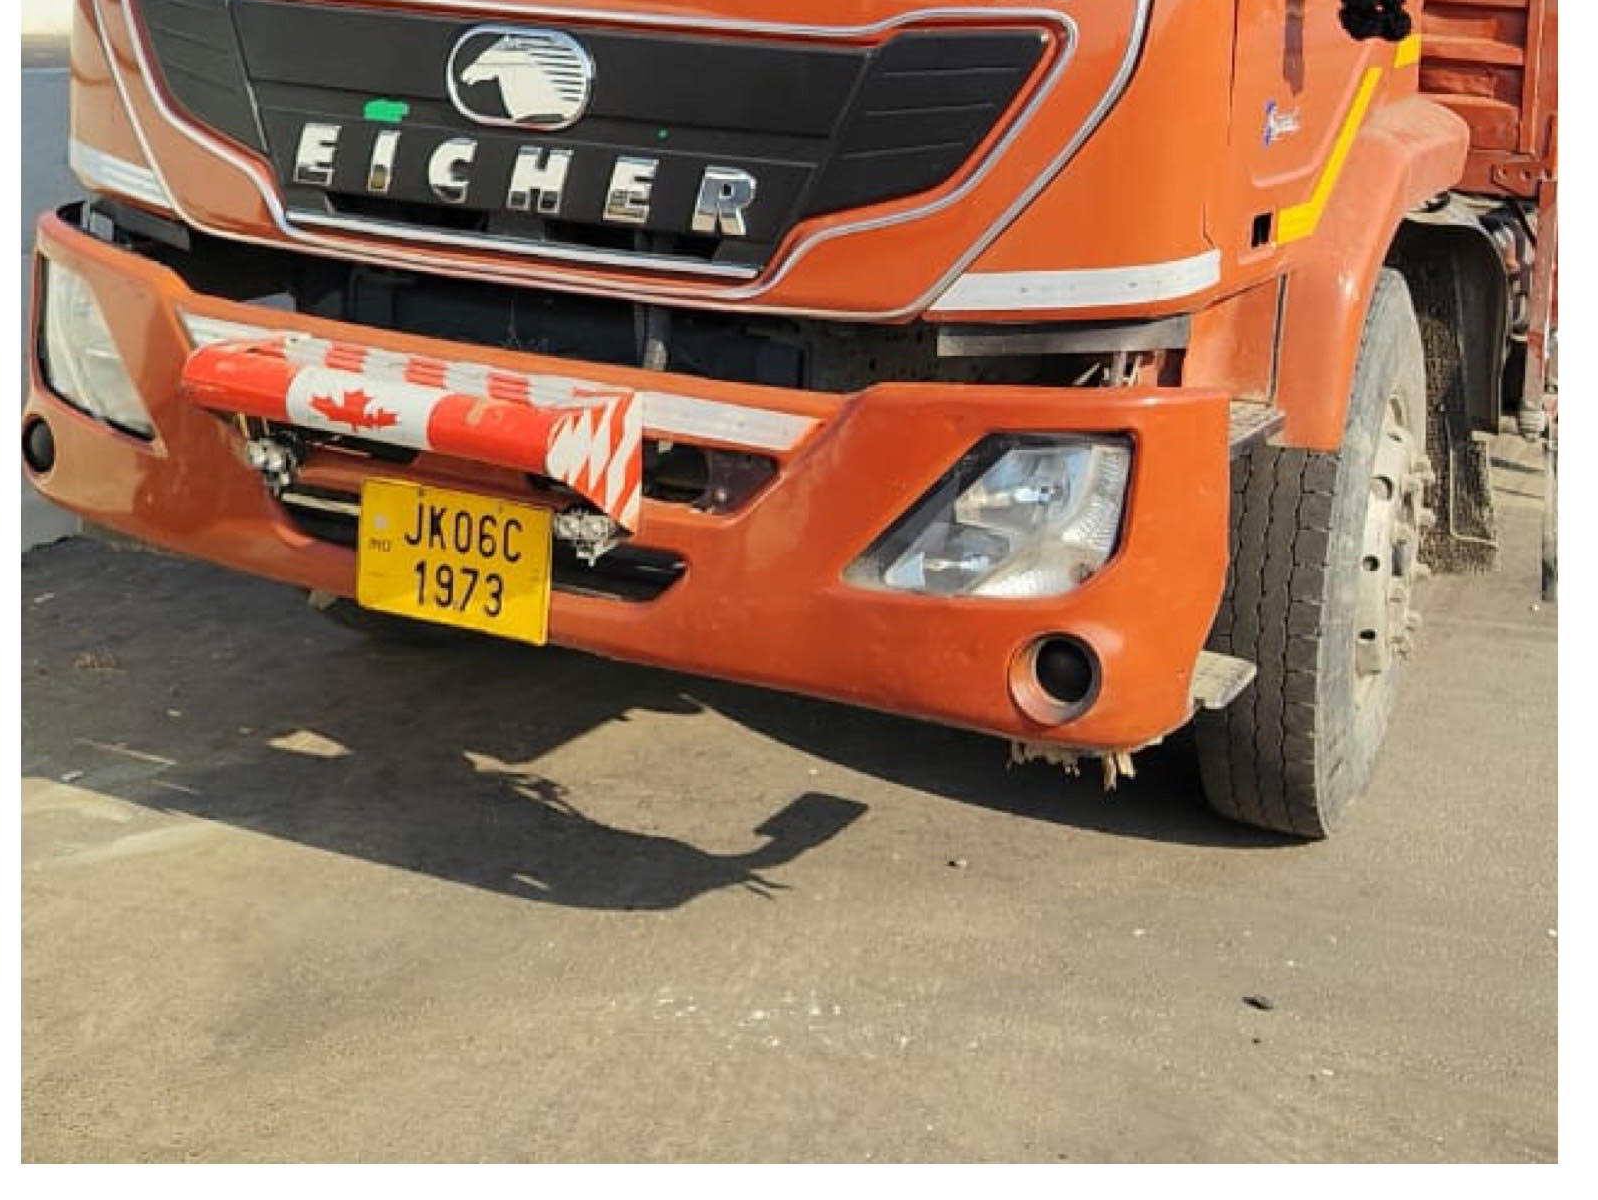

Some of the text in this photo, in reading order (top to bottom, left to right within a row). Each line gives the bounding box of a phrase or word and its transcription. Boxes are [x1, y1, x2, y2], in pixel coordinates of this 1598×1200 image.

[293, 123, 758, 236] EICHER
[404, 502, 523, 563] JK06C
[414, 560, 505, 618] 1973
